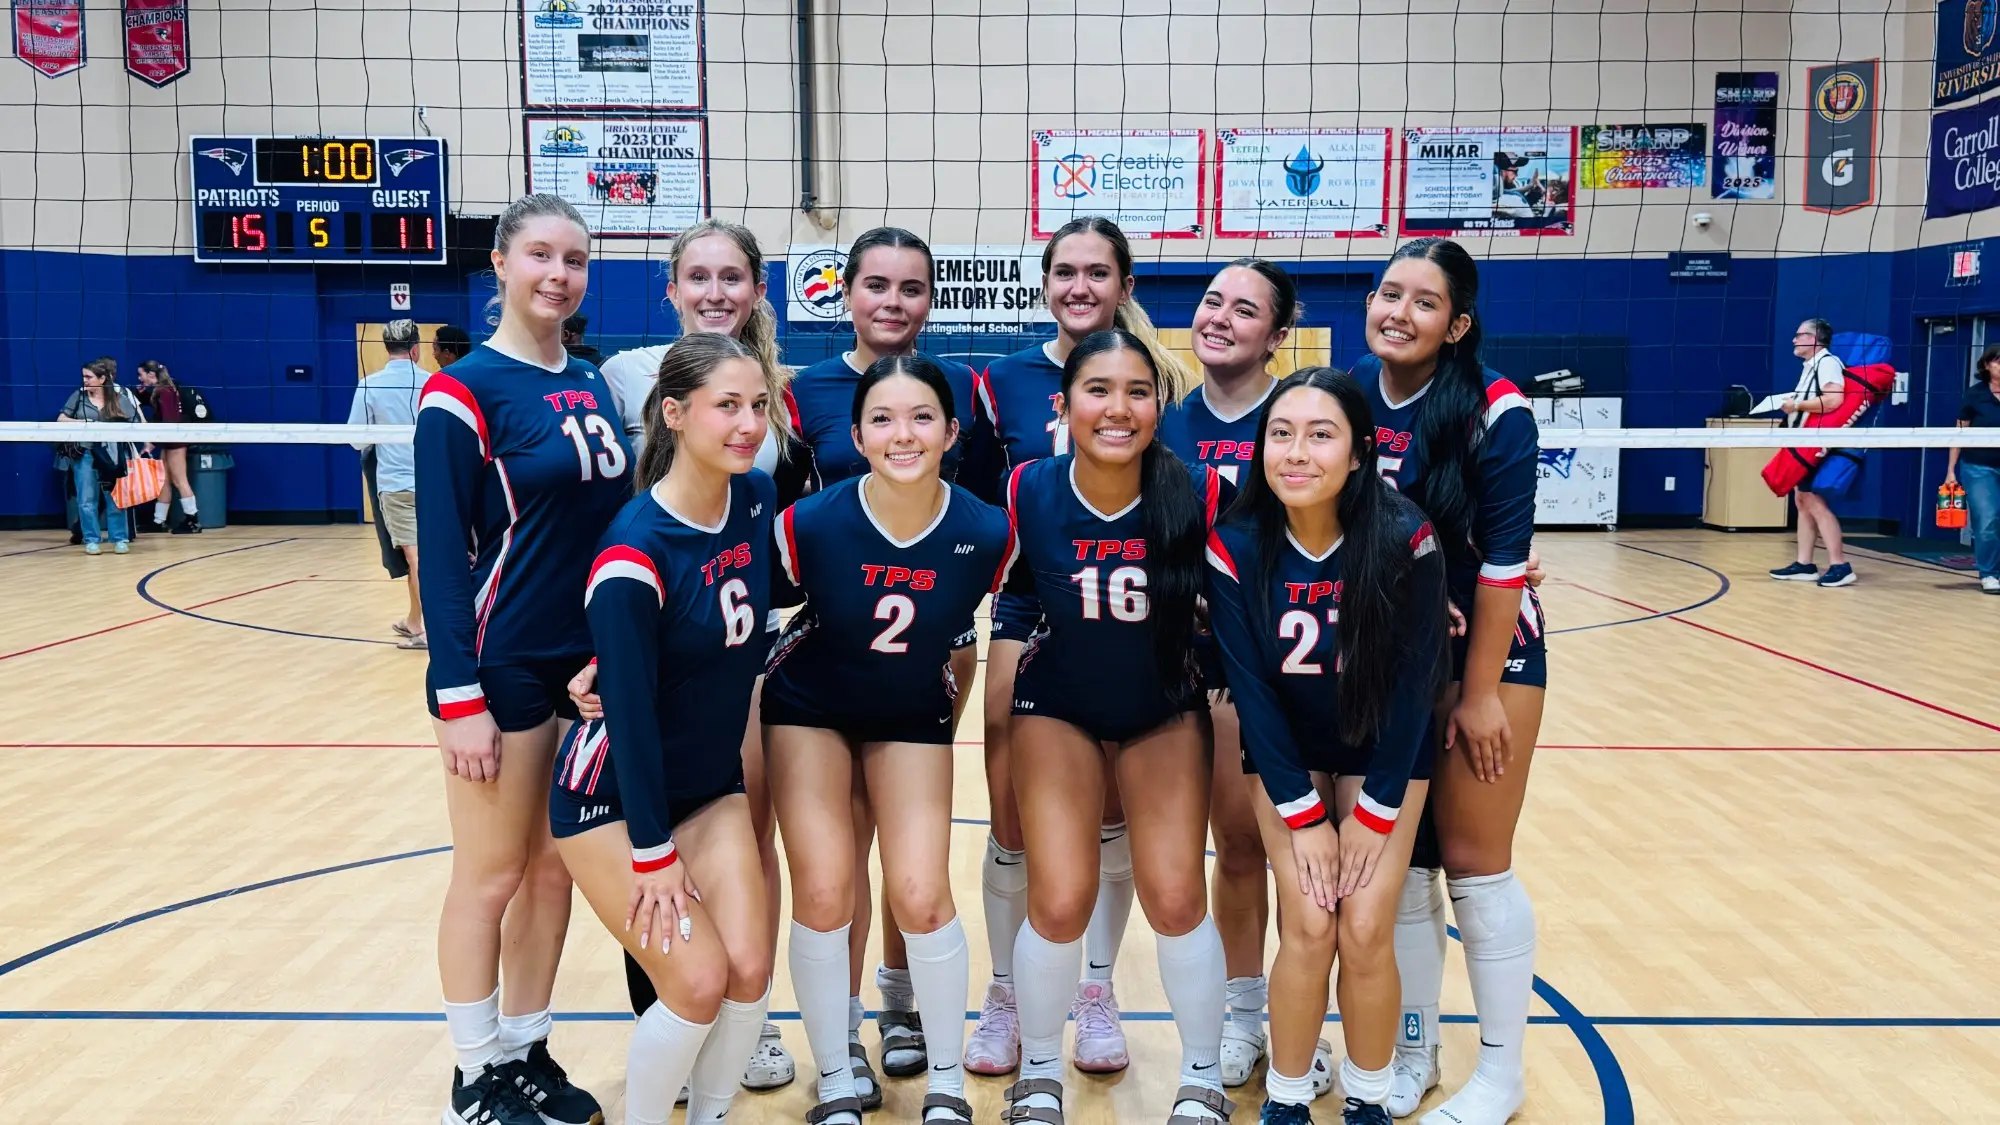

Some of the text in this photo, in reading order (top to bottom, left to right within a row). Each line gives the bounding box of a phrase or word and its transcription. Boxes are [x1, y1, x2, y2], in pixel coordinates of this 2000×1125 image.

[126, 9, 185, 28] CHAMPIONS
[667, 5, 694, 17] CIF
[592, 17, 690, 31] CHAMPIONS
[1939, 62, 1972, 81] UNIVERSITY
[1716, 88, 1776, 103] SHARP
[1035, 131, 1053, 147] TPS
[1220, 130, 1237, 145] TPS
[1404, 129, 1421, 144] TPS
[1721, 120, 1769, 138] Division
[1943, 114, 1999, 160] Carroll
[612, 134, 679, 147] 2023 CIF
[1596, 128, 1691, 151] SHARP
[1718, 141, 1767, 157] Winner
[303, 142, 372, 180] 1:00
[597, 146, 694, 159] CHAMPIONS
[1420, 144, 1480, 158] MIKAR
[1101, 153, 1185, 170] Creative
[1624, 156, 1664, 167] 2025
[1102, 173, 1185, 190] Electron
[1724, 177, 1762, 188] 2025
[197, 188, 281, 208] PATRIOTS
[296, 200, 340, 213] PERIOD
[372, 189, 431, 209] GUEST
[232, 214, 266, 251] 15
[310, 218, 329, 248] 5
[400, 217, 434, 250] 11
[934, 259, 1021, 283] EMECULA
[1002, 286, 1047, 310] SCH
[987, 323, 1023, 333] School
[543, 390, 598, 413] TPS
[560, 413, 627, 483] 13
[1374, 425, 1413, 452] PS
[1197, 440, 1256, 461] TPS
[1071, 539, 1148, 561] TPS
[700, 541, 752, 587] TPS
[860, 564, 937, 591] TPS
[1071, 565, 1150, 622] 16
[719, 576, 755, 649] 6
[869, 593, 917, 654] 2
